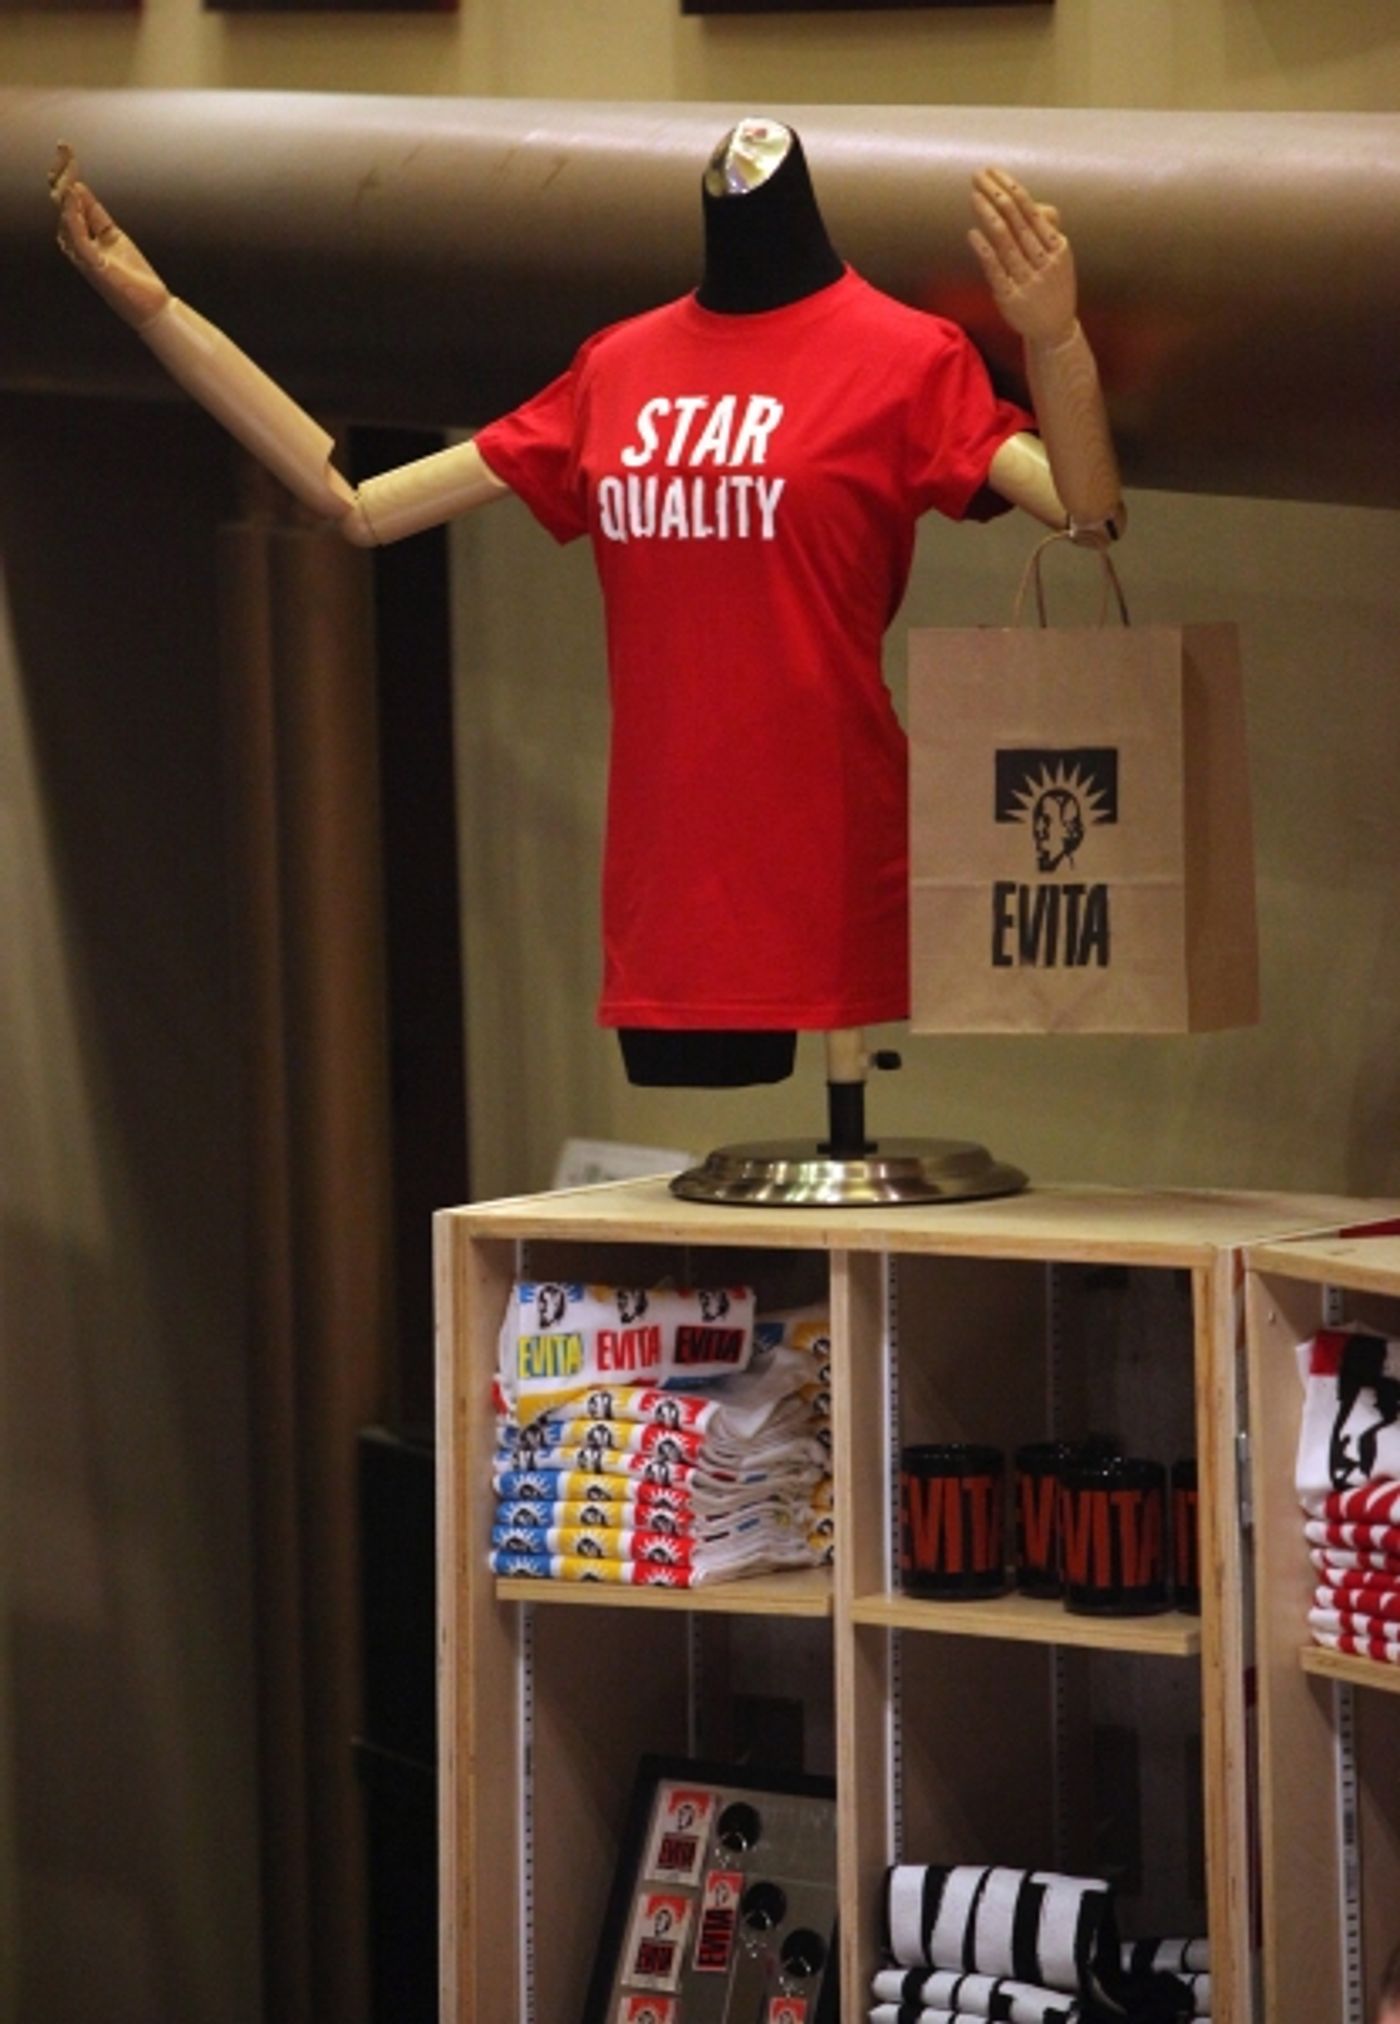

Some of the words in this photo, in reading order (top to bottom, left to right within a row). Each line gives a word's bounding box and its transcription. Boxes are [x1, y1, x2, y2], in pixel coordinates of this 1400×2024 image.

[621, 394, 784, 467] STAR
[598, 473, 785, 543] QUALITY
[992, 881, 1110, 968] EVITA
[517, 1332, 584, 1379] EVITA
[596, 1325, 661, 1371] EVITA
